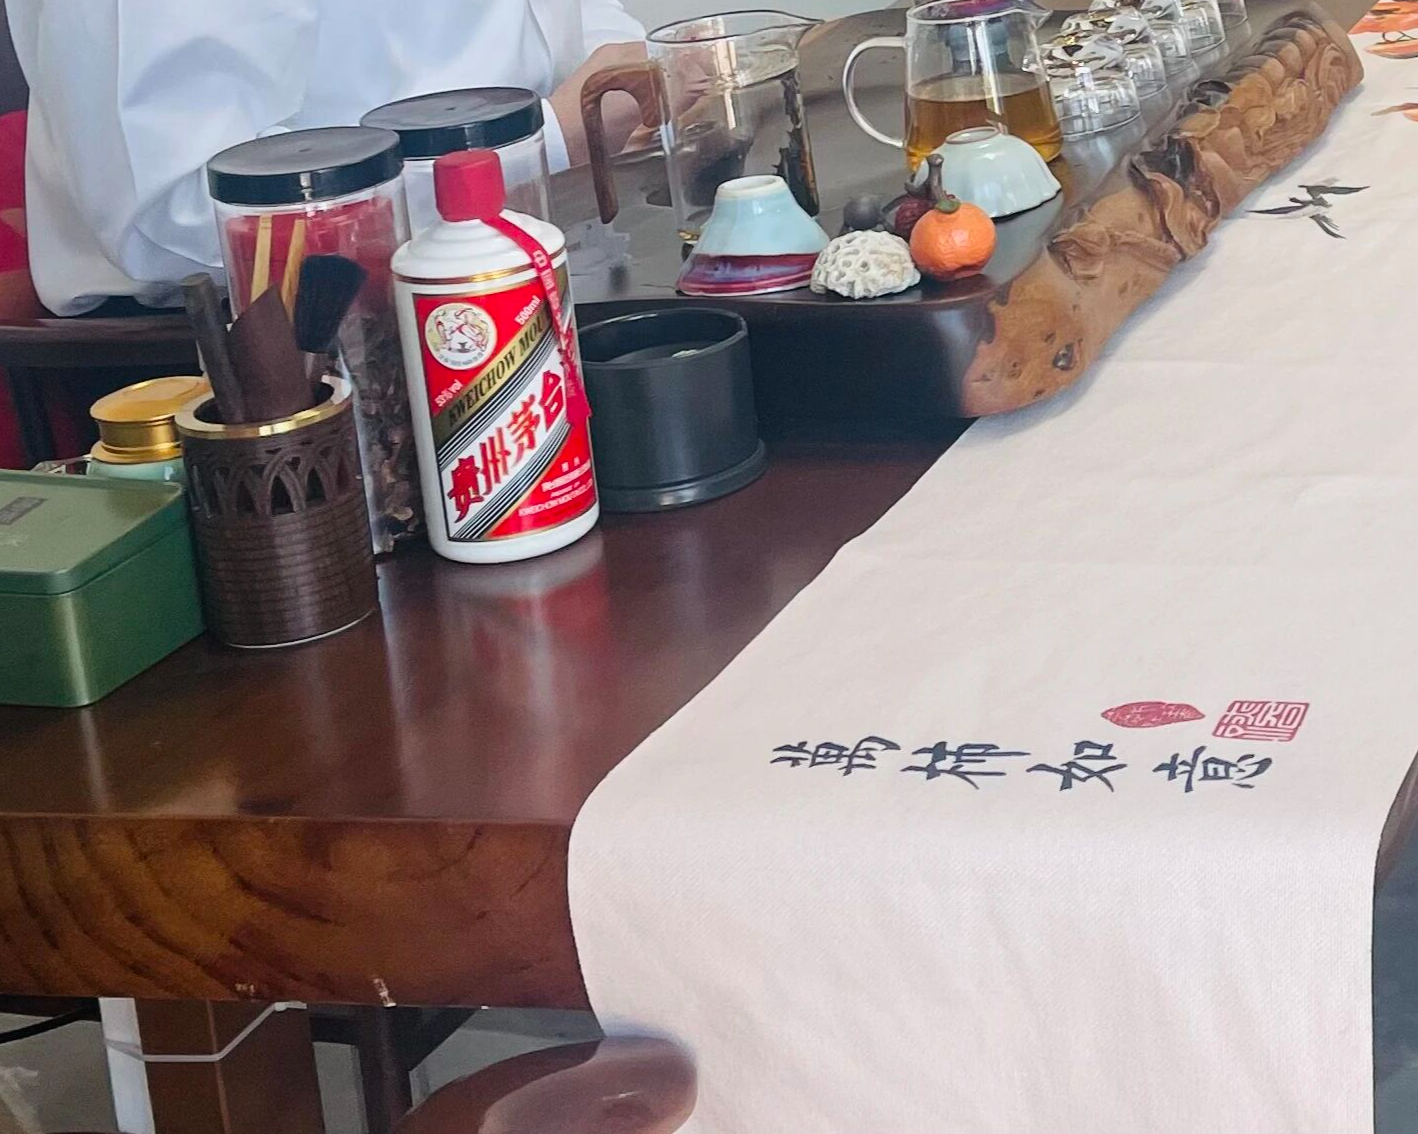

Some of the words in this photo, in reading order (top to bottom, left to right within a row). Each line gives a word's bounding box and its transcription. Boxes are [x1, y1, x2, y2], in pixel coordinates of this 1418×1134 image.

[514, 295, 541, 326] 500ml
[449, 345, 518, 426] KWEICHOW
[447, 369, 567, 524] 贵州茅台
